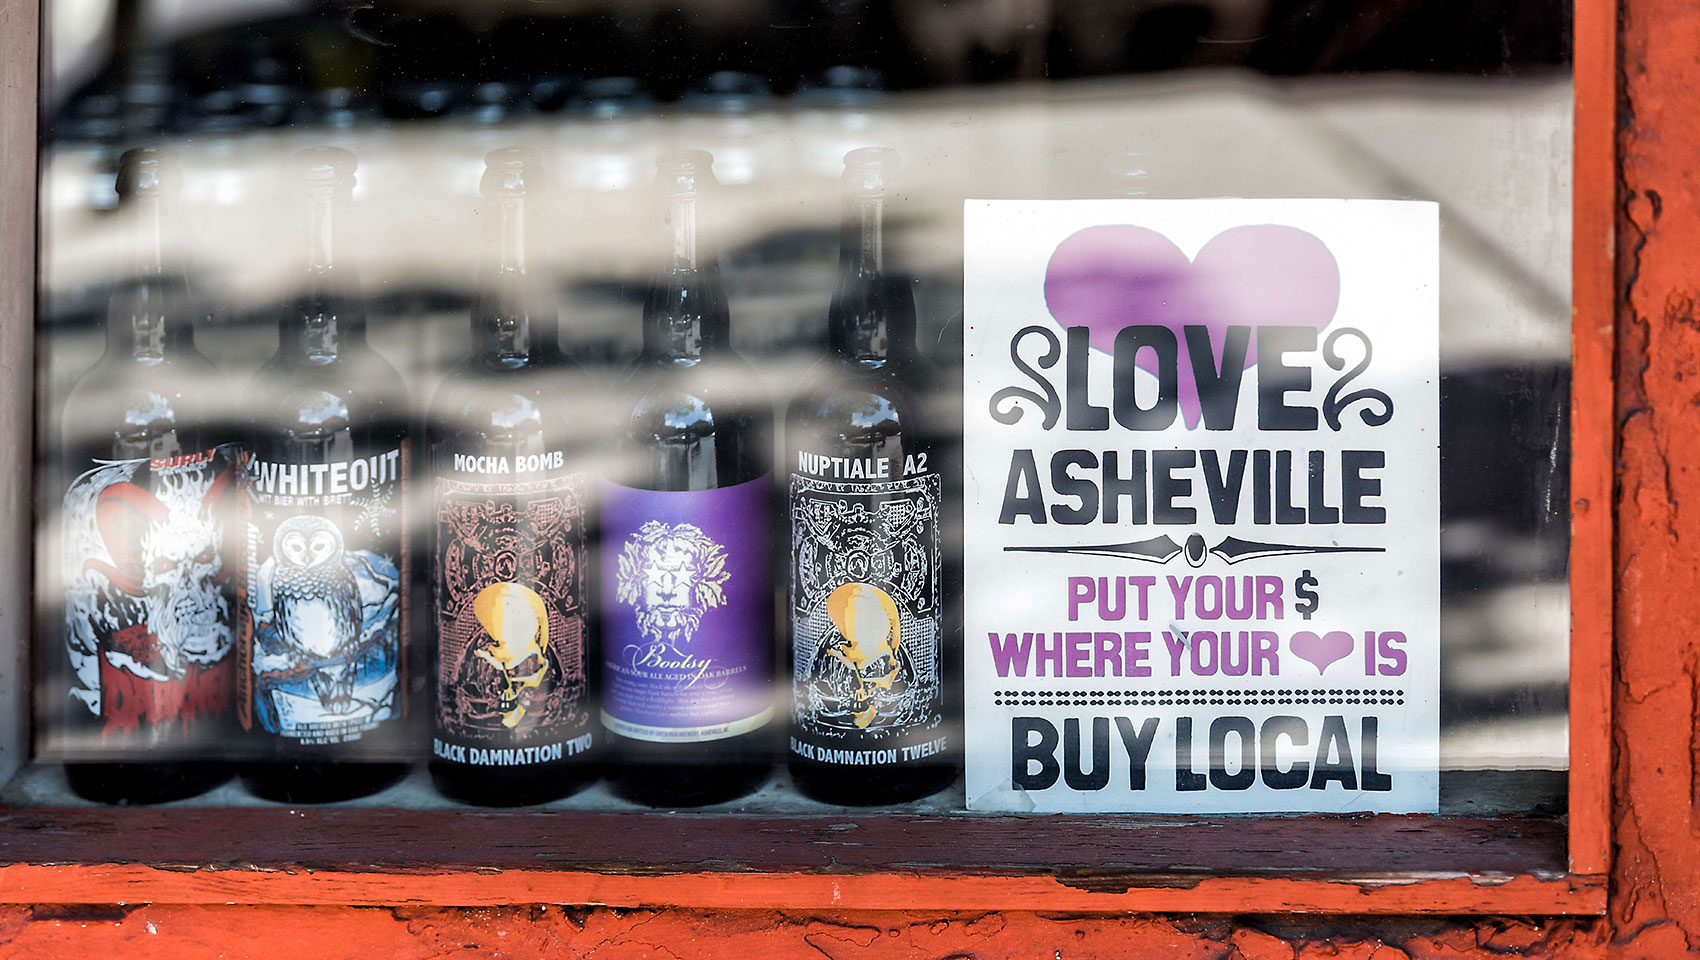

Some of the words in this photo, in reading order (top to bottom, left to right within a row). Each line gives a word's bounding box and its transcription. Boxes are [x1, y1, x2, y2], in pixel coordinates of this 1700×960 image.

[1066, 325, 1319, 431] LOVE
[149, 448, 216, 471] SURLY
[254, 448, 399, 496] WHITEOUT
[454, 453, 510, 475] MOCHA
[515, 450, 564, 474] BOMB
[798, 450, 889, 479] NUPTIALE
[903, 452, 928, 476] A2
[998, 449, 1387, 525] ASHEVILLE
[1068, 576, 1156, 622] PUT
[1166, 575, 1284, 621] YOUR
[1295, 569, 1319, 620] $
[626, 643, 712, 690] Bootsy
[649, 671, 663, 680] ALE
[664, 673, 685, 681] AGED
[988, 632, 1152, 678] WHERE
[1162, 631, 1280, 677] YOUR
[1365, 631, 1408, 676] IS
[433, 738, 466, 763] BLACK
[469, 743, 562, 766] DAMNATION
[567, 732, 593, 756] TWO
[790, 736, 815, 760] BLACK
[817, 747, 897, 765] DAMNATION
[901, 736, 948, 762] TWELVE
[1011, 717, 1160, 791] BUY
[1175, 716, 1392, 791] LOCAL
